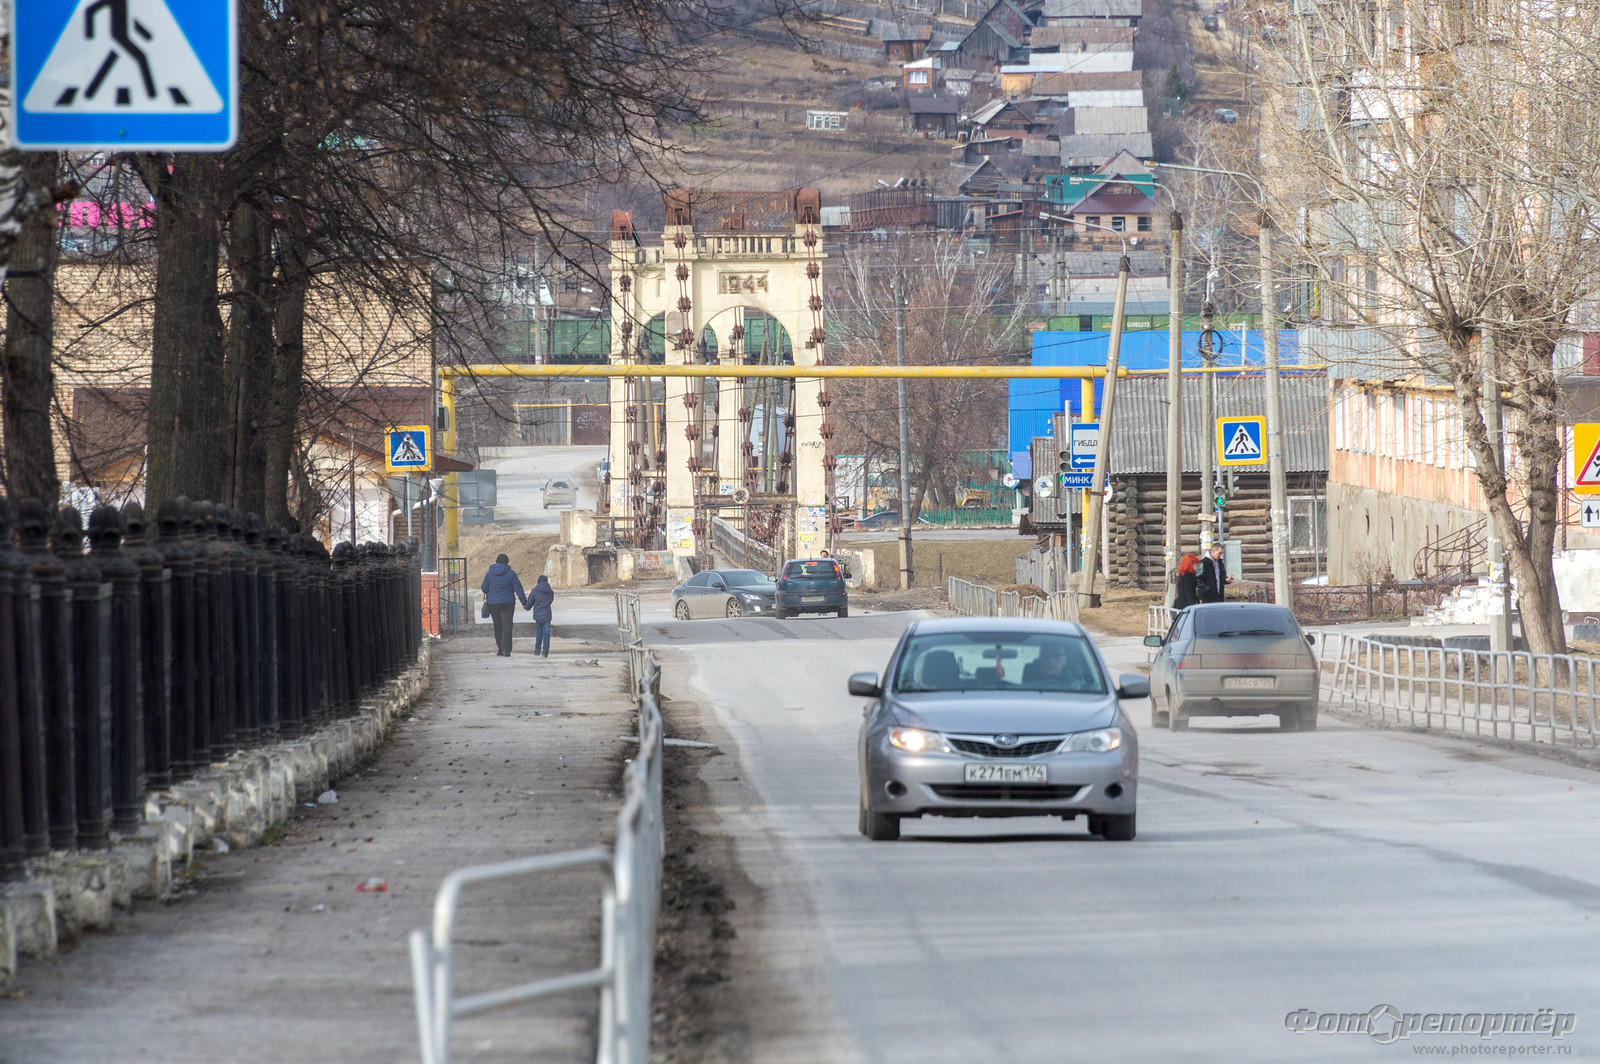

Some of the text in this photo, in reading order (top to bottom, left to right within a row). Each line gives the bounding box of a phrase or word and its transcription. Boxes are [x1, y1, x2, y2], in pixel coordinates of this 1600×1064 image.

[721, 274, 768, 294] 1944
[1073, 439, 1098, 447] ГИБДД
[1023, 765, 1043, 776] 174
